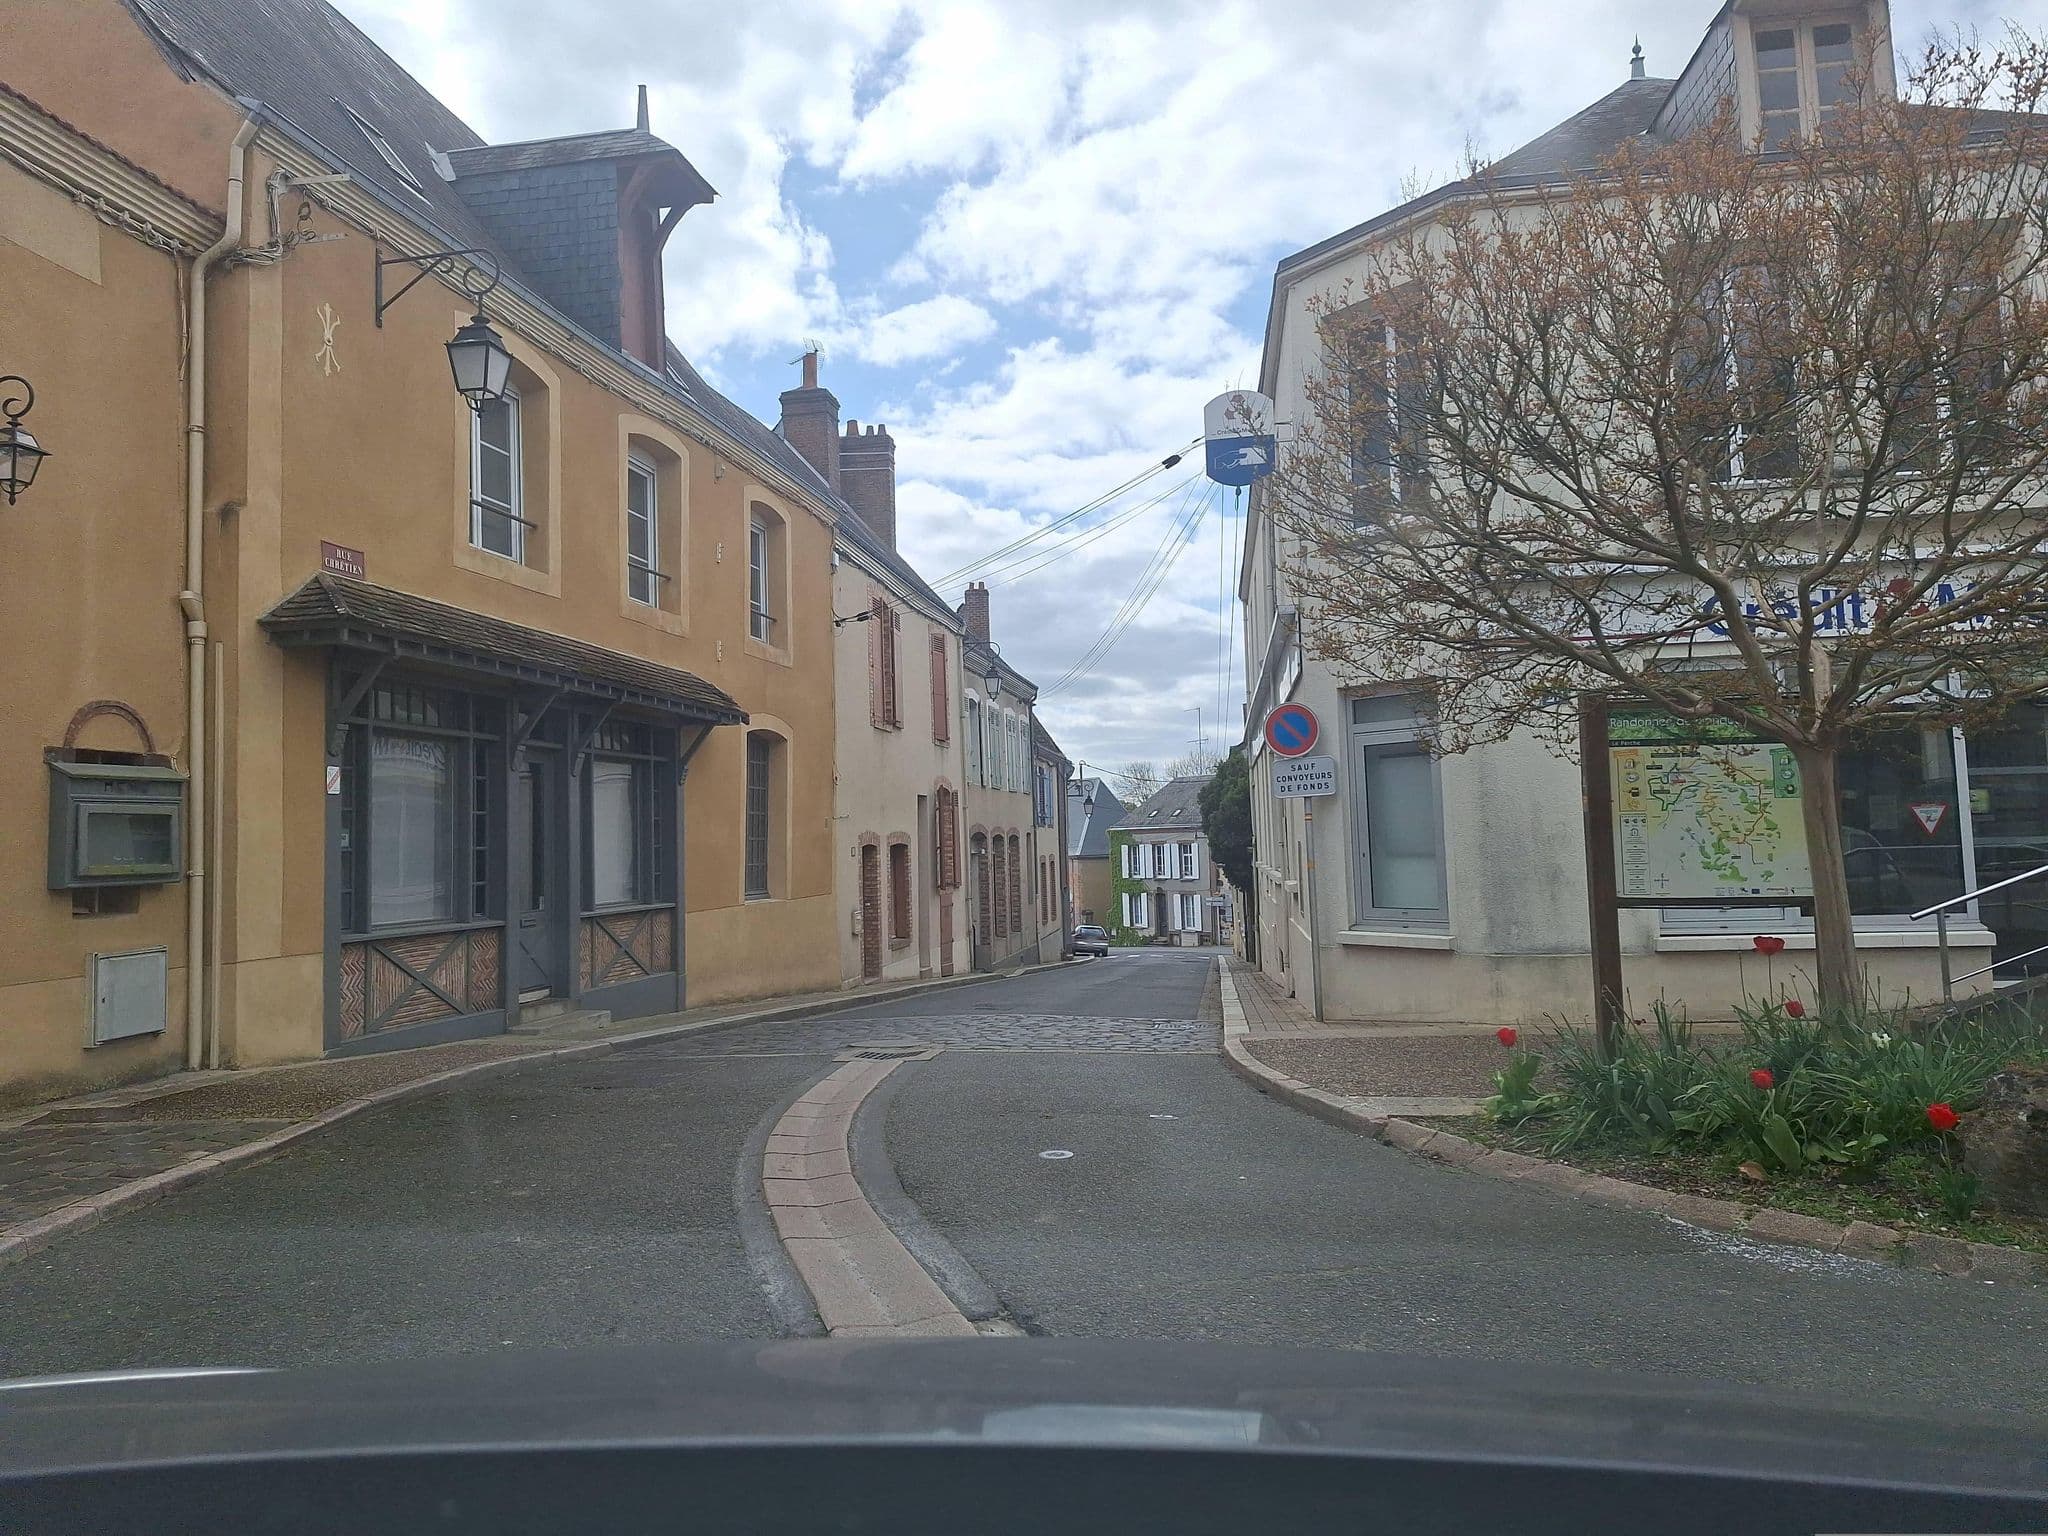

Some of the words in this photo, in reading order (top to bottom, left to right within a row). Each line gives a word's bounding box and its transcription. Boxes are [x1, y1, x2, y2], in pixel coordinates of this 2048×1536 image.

[336, 548, 352, 561] RUE
[1291, 762, 1316, 772] SAUF
[1276, 771, 1332, 783] CONVOYEURS
[1280, 783, 1292, 792] DE
[1297, 782, 1330, 791] FONDS
